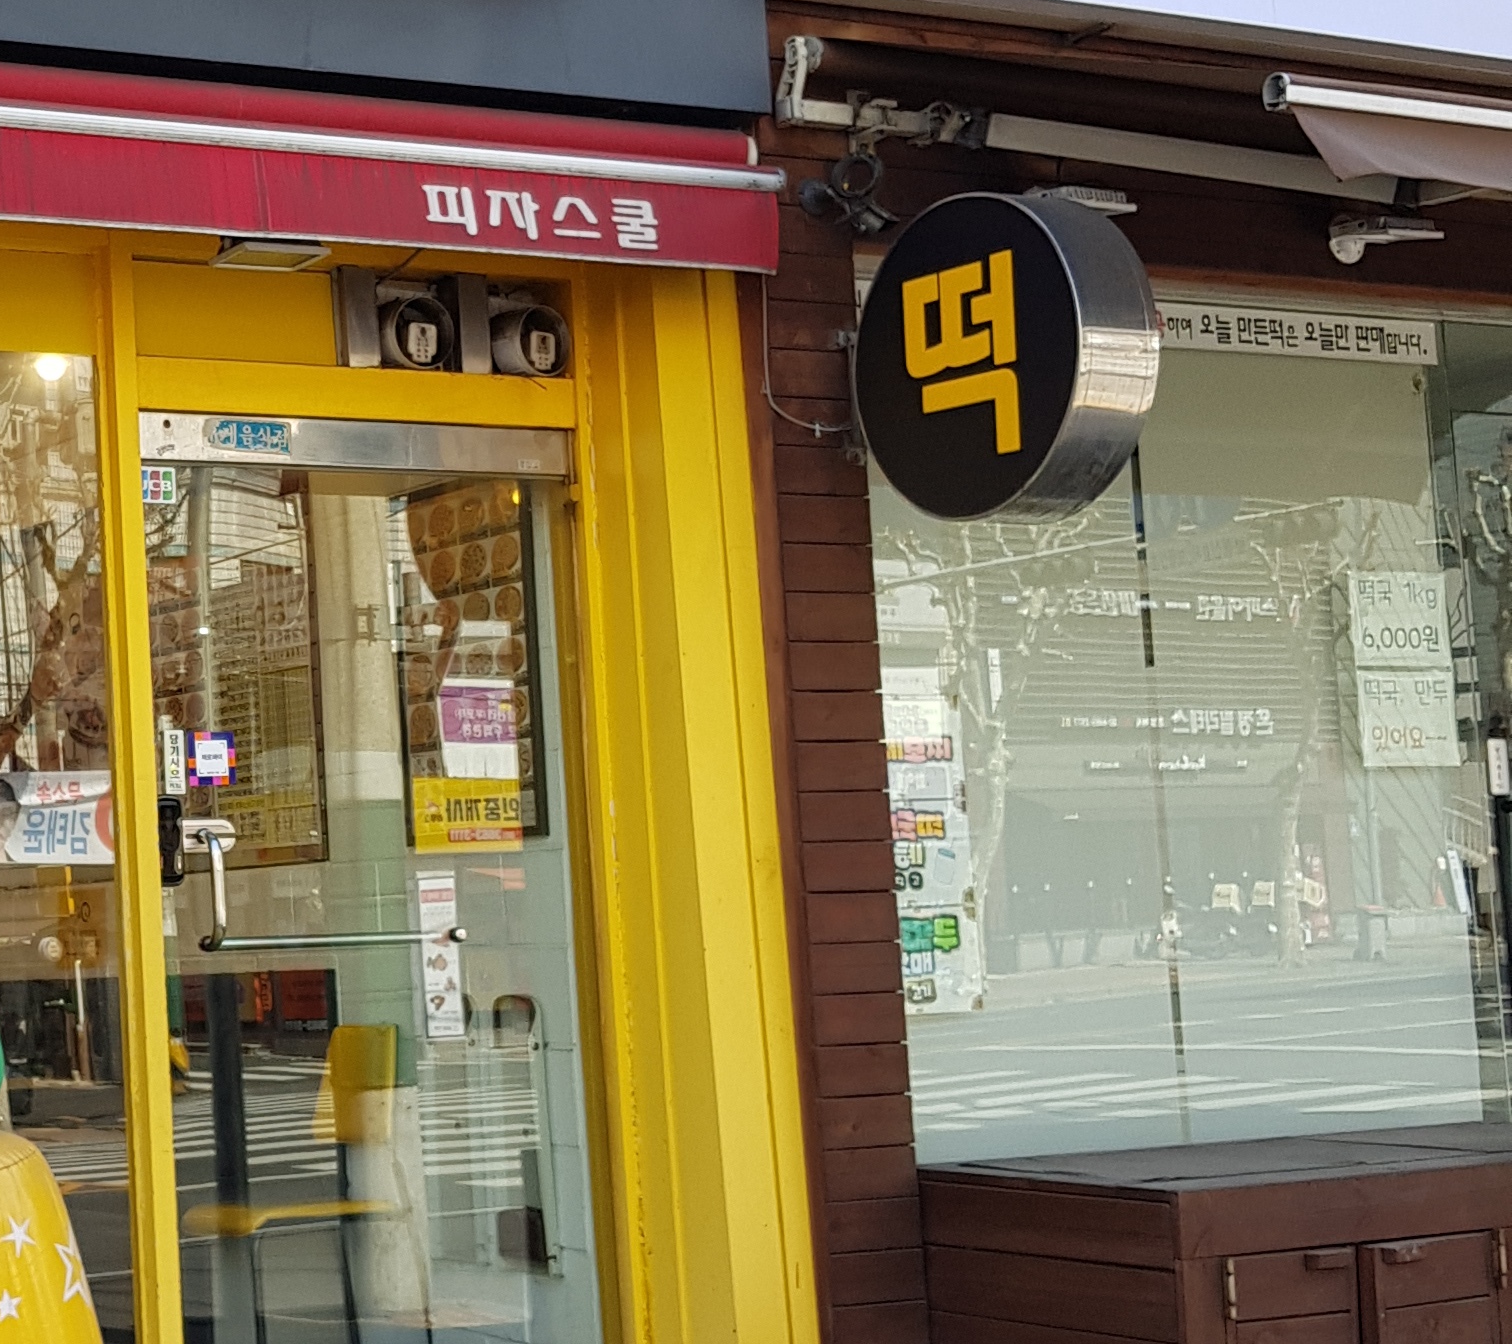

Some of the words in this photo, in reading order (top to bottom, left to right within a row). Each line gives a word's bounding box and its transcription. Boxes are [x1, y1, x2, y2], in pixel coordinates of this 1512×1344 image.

[421, 182, 659, 253] 피자스쿨
[1199, 314, 1232, 345] 오늘
[1237, 316, 1299, 349] 만든떡은
[1304, 321, 1351, 352] 오늘만
[901, 249, 1022, 455] 떡
[1357, 579, 1393, 607] 떡국
[1403, 581, 1438, 610] 1kg
[1361, 624, 1441, 653] 6,000원
[1414, 679, 1448, 706] 만두
